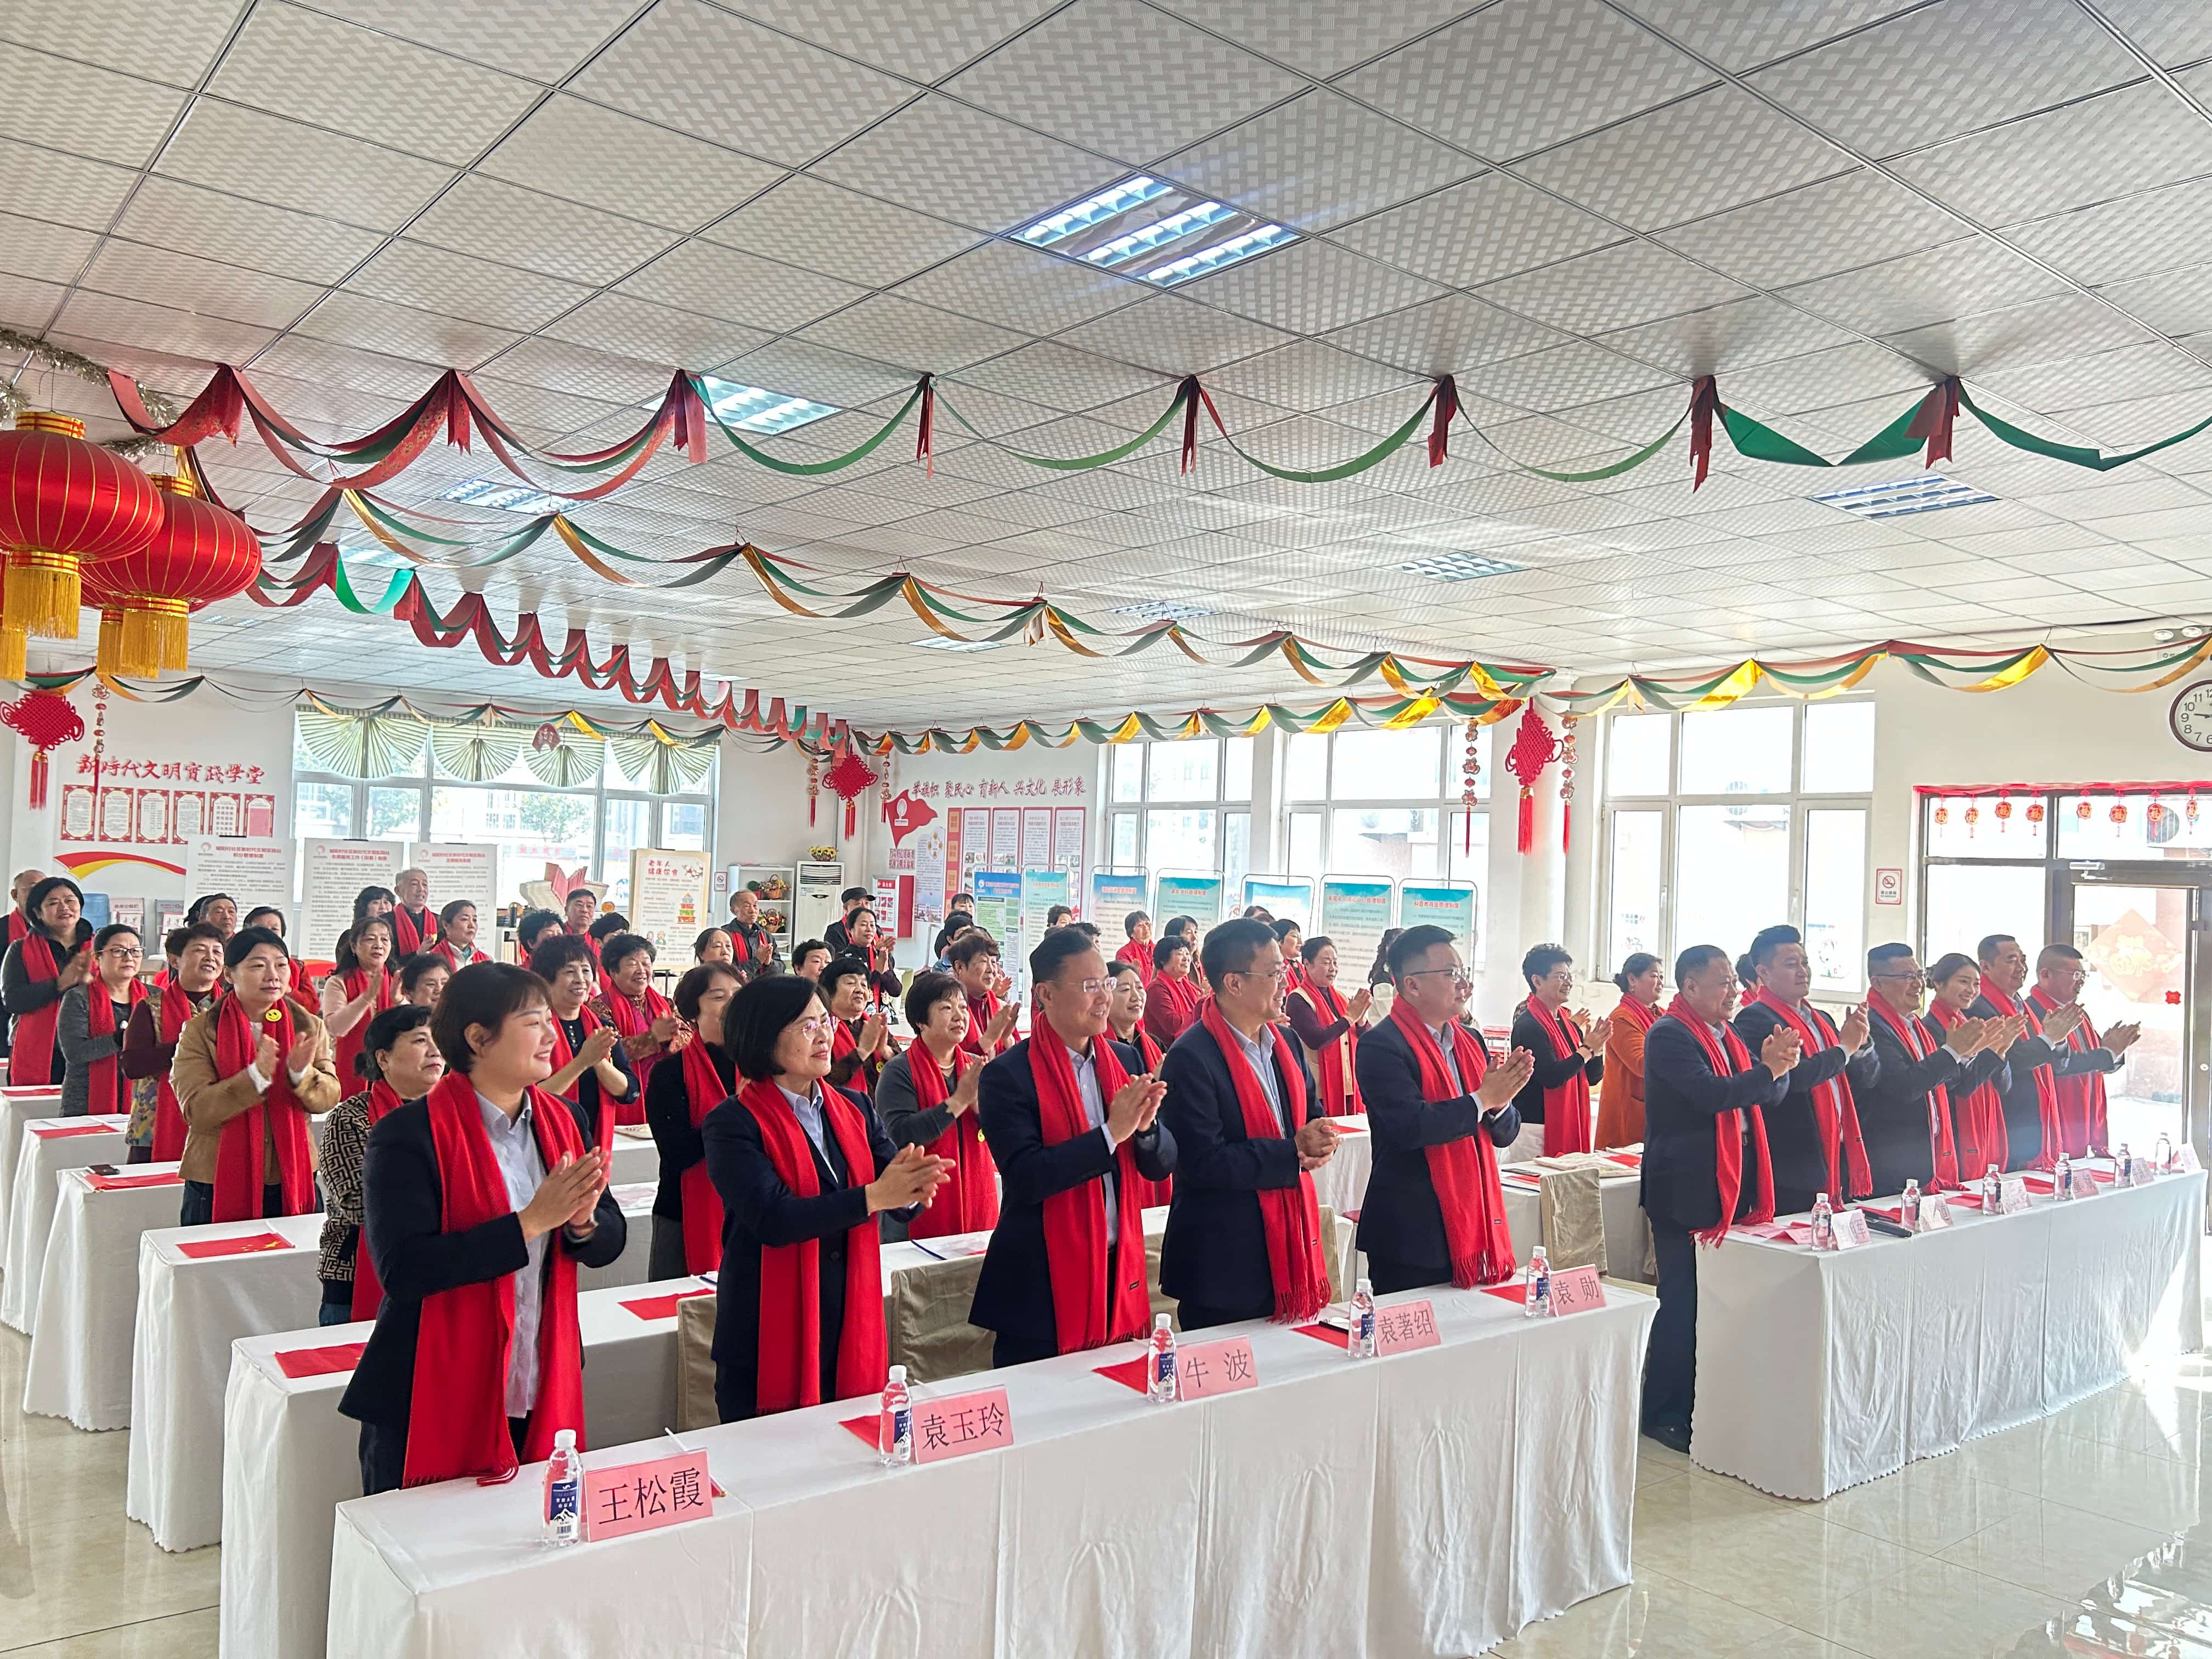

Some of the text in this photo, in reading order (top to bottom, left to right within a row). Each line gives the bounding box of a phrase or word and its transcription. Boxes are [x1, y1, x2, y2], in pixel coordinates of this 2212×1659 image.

[2193, 693, 2202, 703] 11
[2184, 702, 2194, 712] 10
[2181, 713, 2189, 722] 9
[2184, 725, 2192, 733] 8
[2194, 732, 2202, 742] 7
[978, 779, 1010, 798] 育新人
[1014, 778, 1046, 797] 兴文化
[1051, 775, 1087, 798] 展形象
[1554, 1274, 1599, 1306] 袁 勋
[920, 1401, 1005, 1451] 袁玉玲
[598, 1466, 705, 1525] 王松霞
